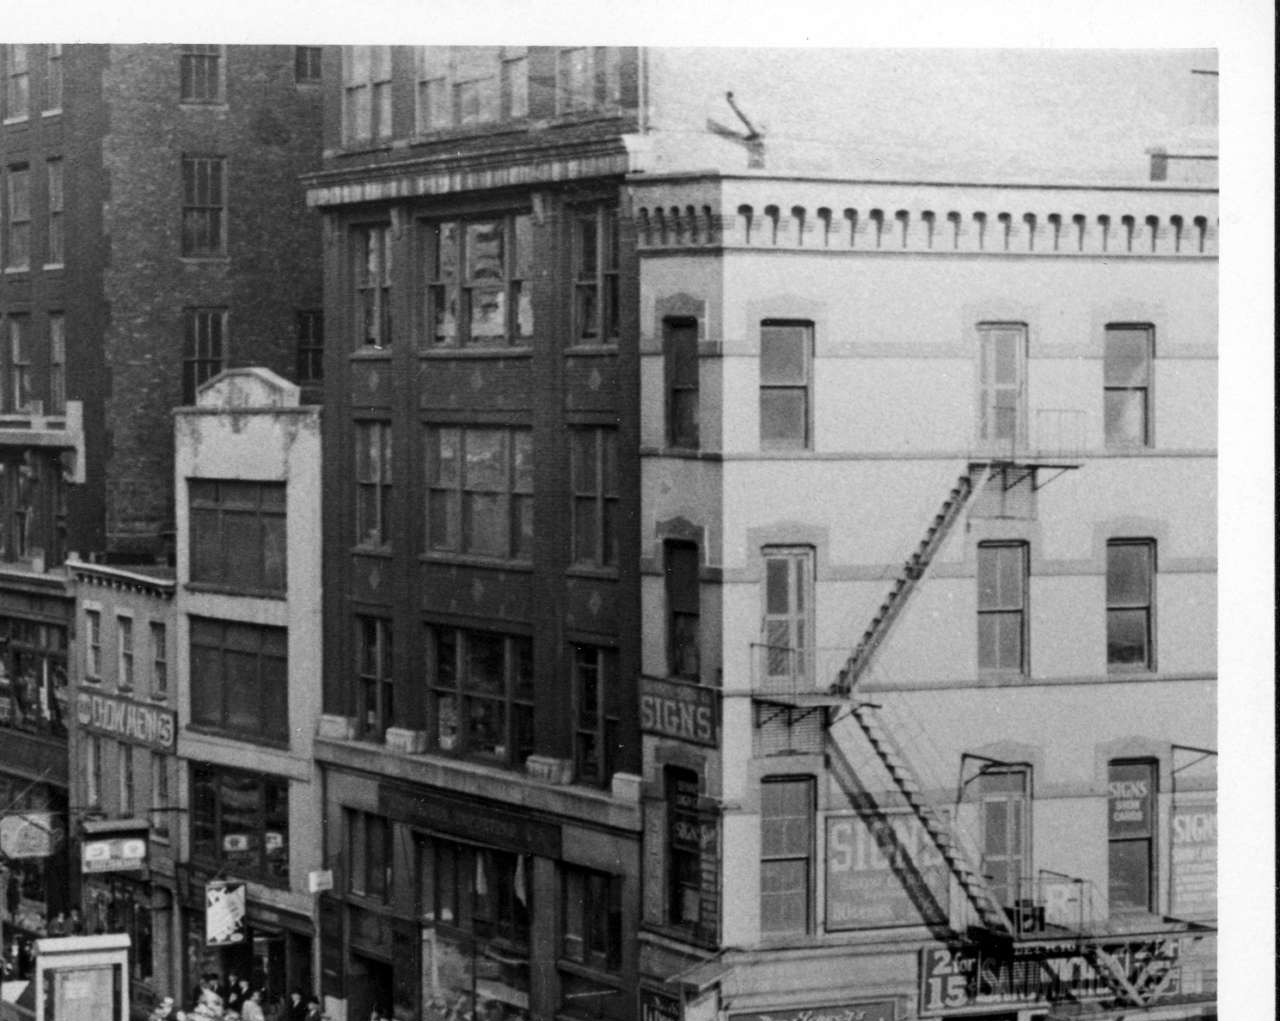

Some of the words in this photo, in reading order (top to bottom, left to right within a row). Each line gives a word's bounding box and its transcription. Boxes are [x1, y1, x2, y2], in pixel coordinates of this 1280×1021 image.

[641, 695, 711, 739] SIGNS
[1108, 780, 1148, 798] SIGNS
[932, 949, 952, 975] 2
